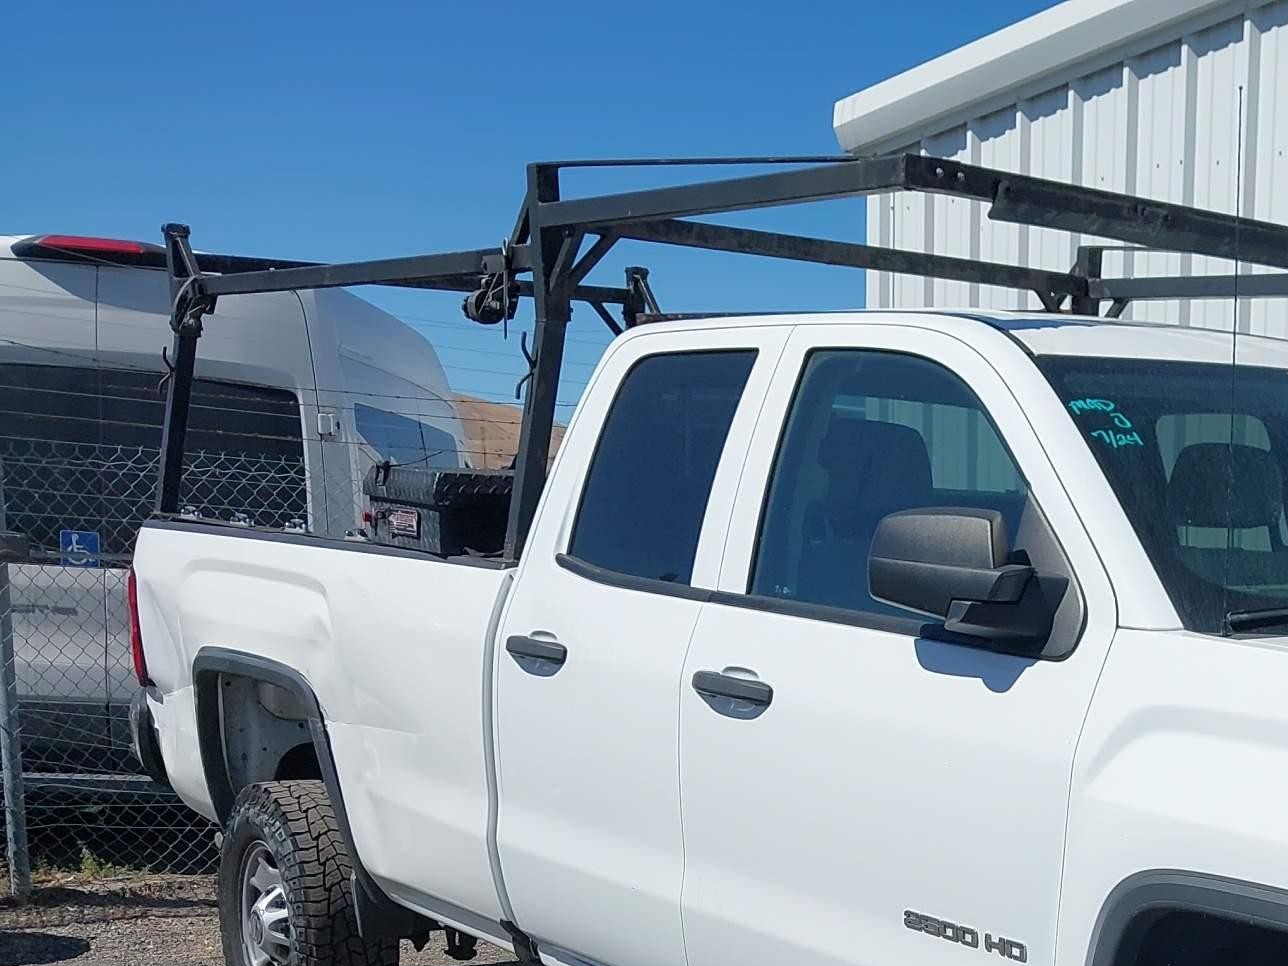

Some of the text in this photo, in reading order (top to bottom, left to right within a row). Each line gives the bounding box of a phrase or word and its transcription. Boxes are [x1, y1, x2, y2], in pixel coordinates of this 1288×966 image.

[1090, 429, 1144, 449] 7/24
[903, 909, 1028, 963] 2500 HD
